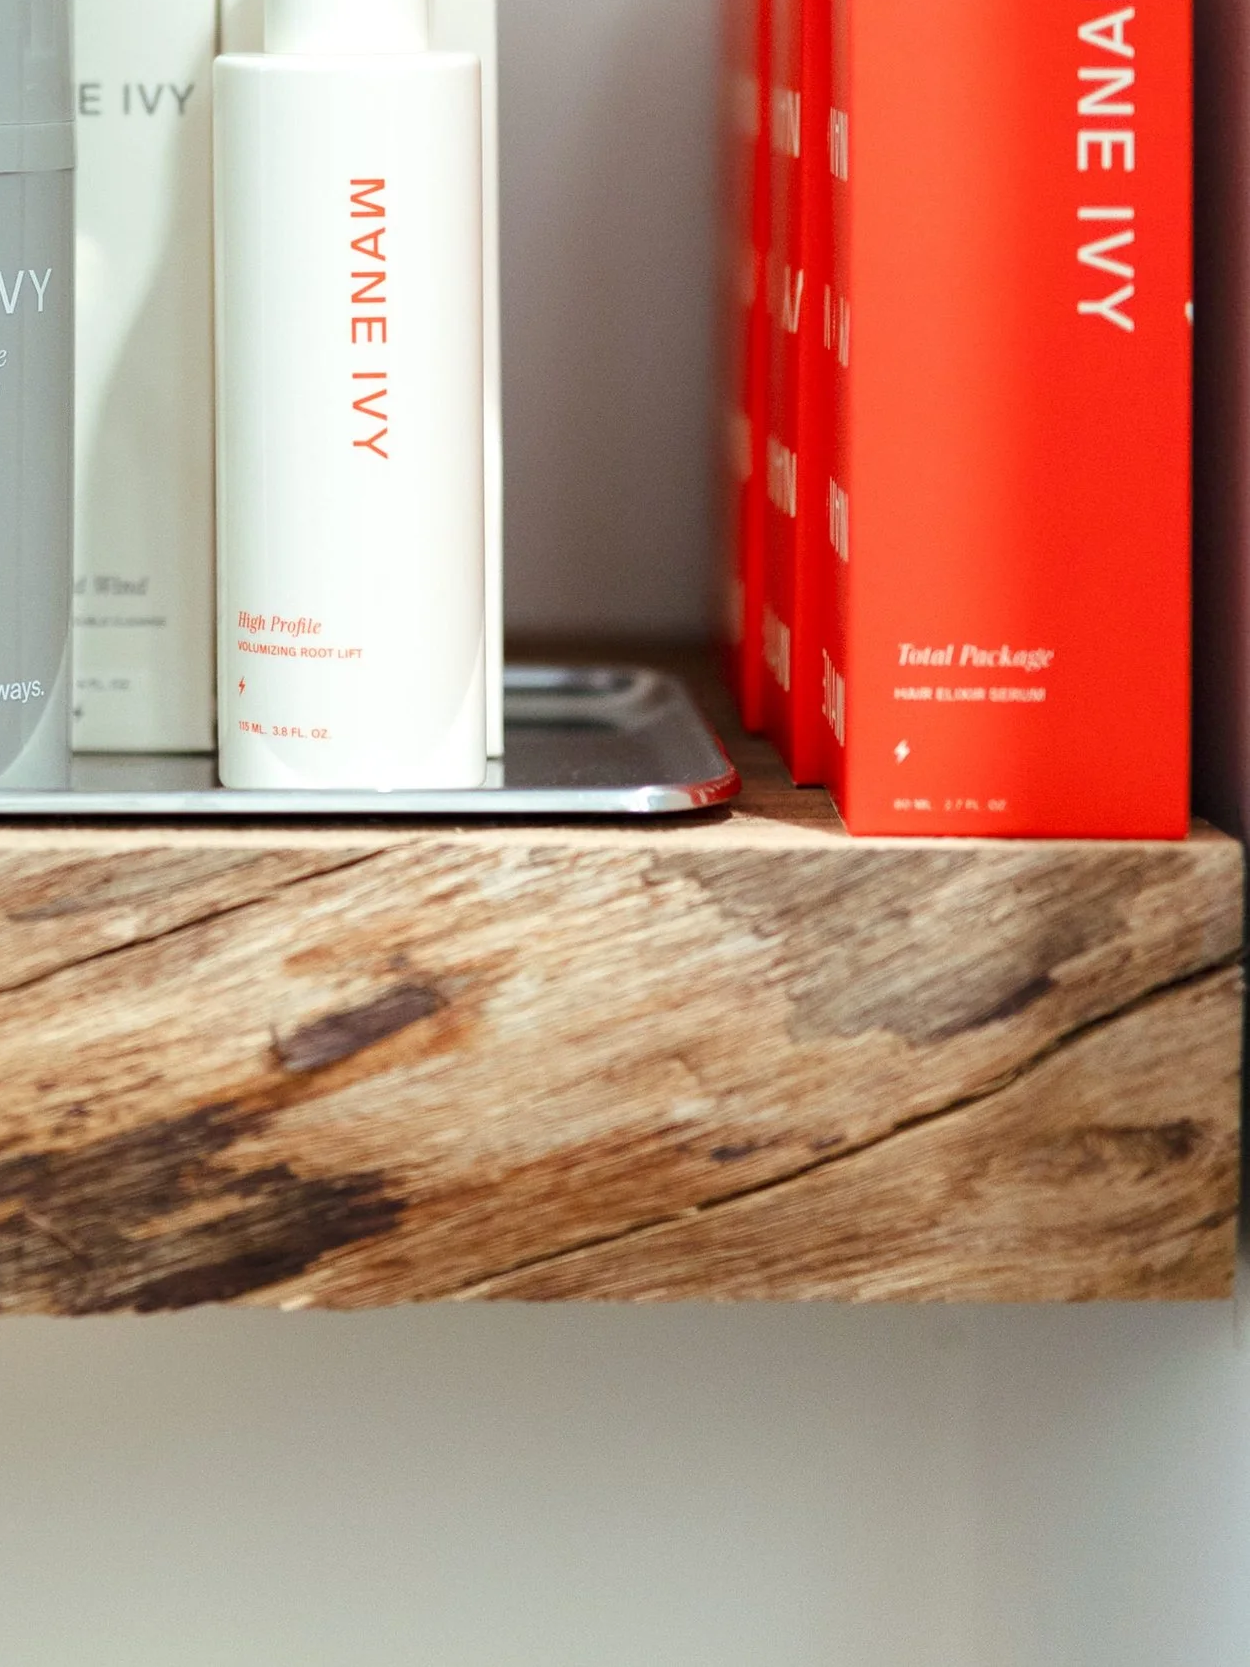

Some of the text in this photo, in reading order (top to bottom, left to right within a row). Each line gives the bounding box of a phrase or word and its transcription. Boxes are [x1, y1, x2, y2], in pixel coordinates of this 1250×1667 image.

[123, 83, 195, 116] IVY
[1077, 206, 1136, 332] IVY
[352, 372, 389, 460] IVY
[238, 611, 322, 638] High Profile
[238, 640, 363, 659] VOLUMIZING ROOT LIFT
[899, 643, 1055, 673] Total Package
[272, 726, 288, 736] 3.8
